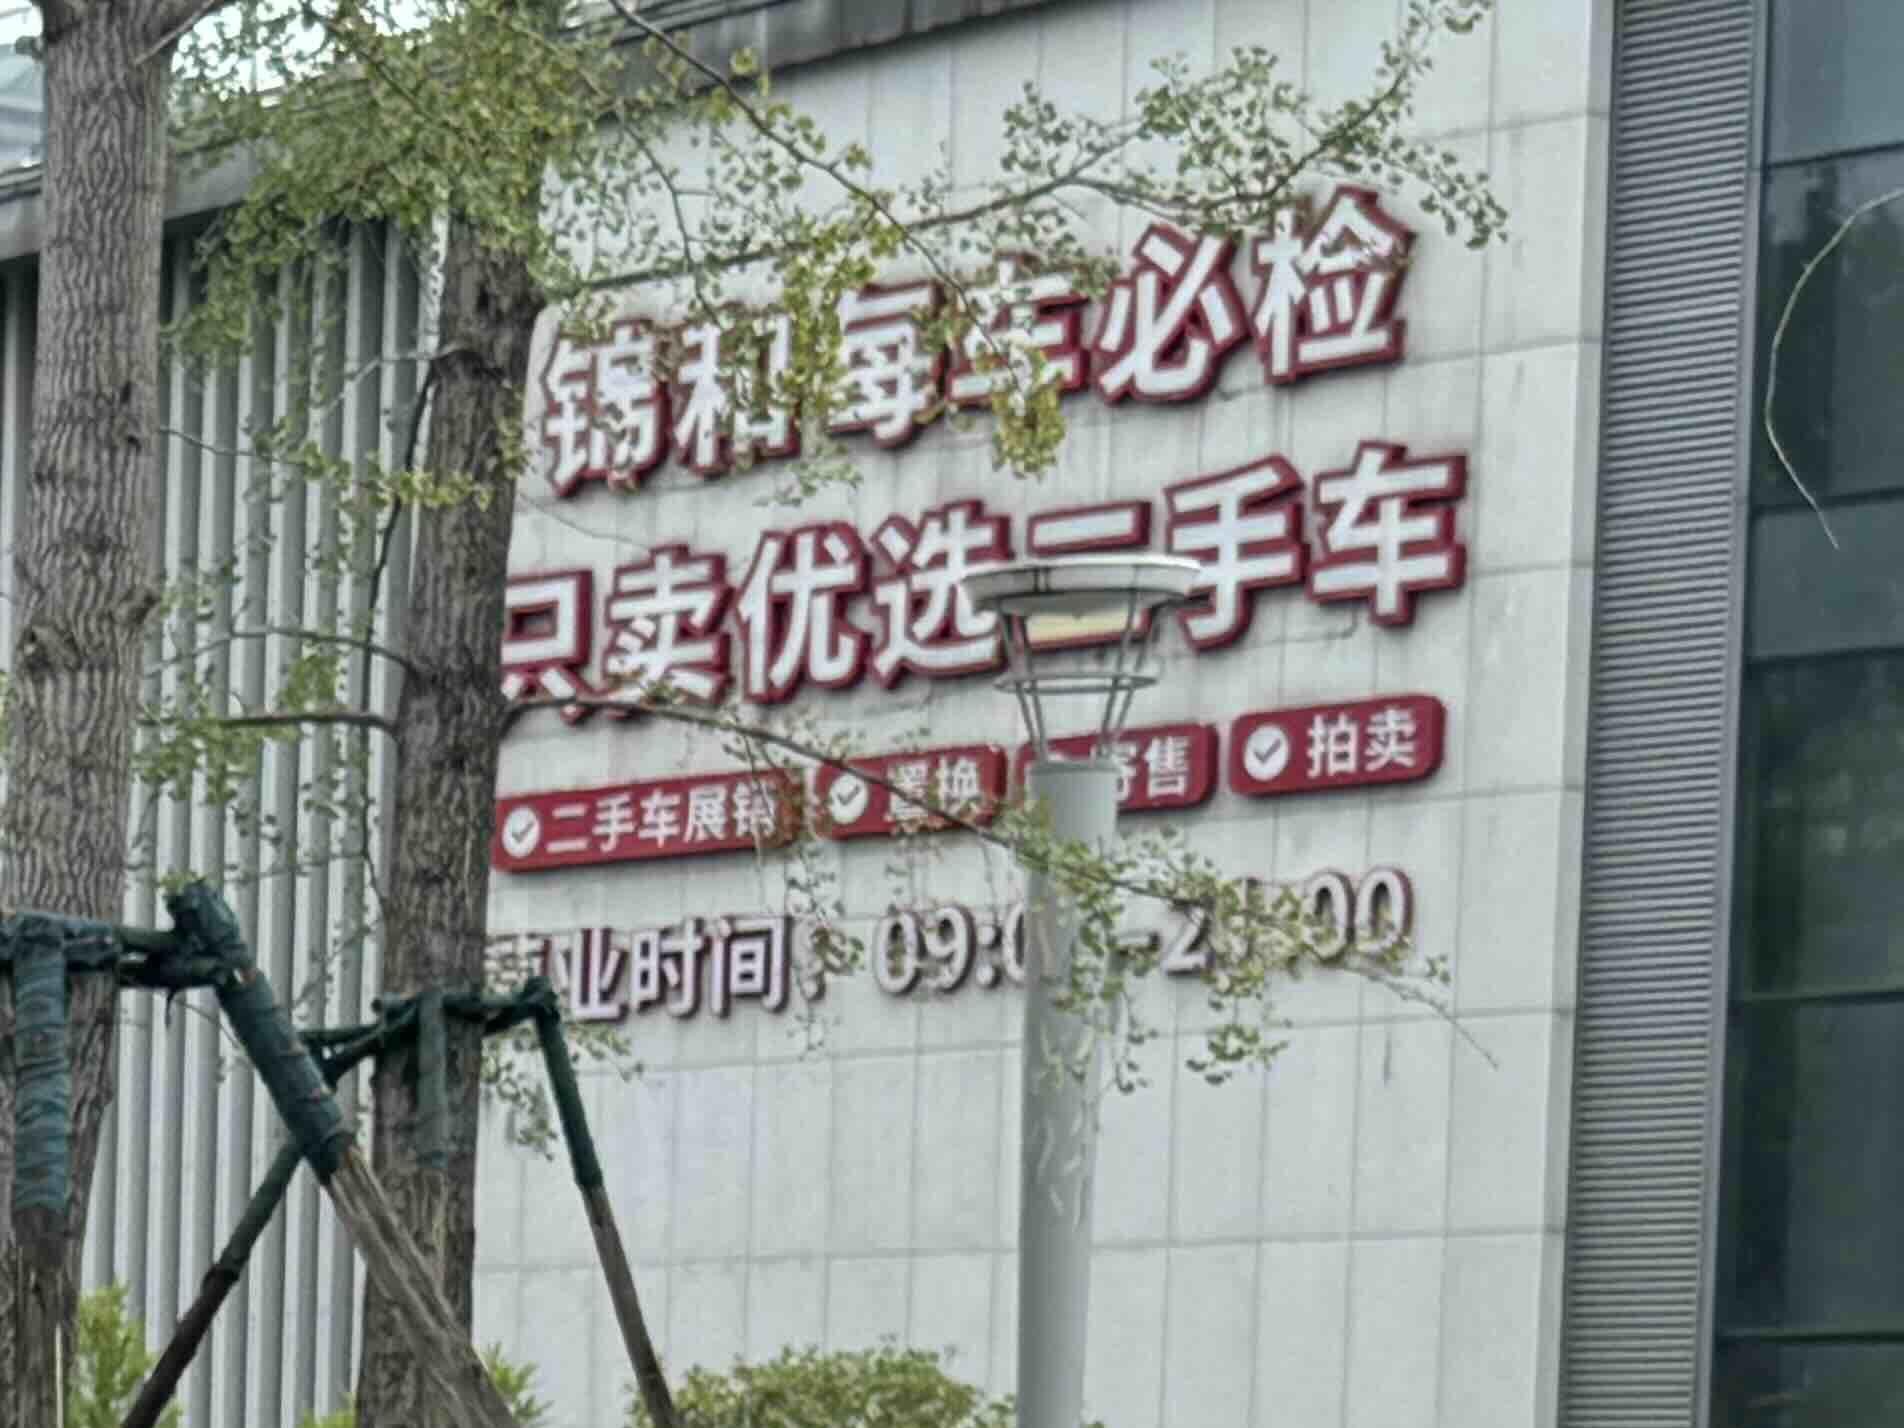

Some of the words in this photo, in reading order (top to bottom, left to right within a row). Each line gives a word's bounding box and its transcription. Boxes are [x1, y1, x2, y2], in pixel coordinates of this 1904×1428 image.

[500, 442, 1464, 722] 只卖优选二手车
[1306, 705, 1417, 778] 拍卖
